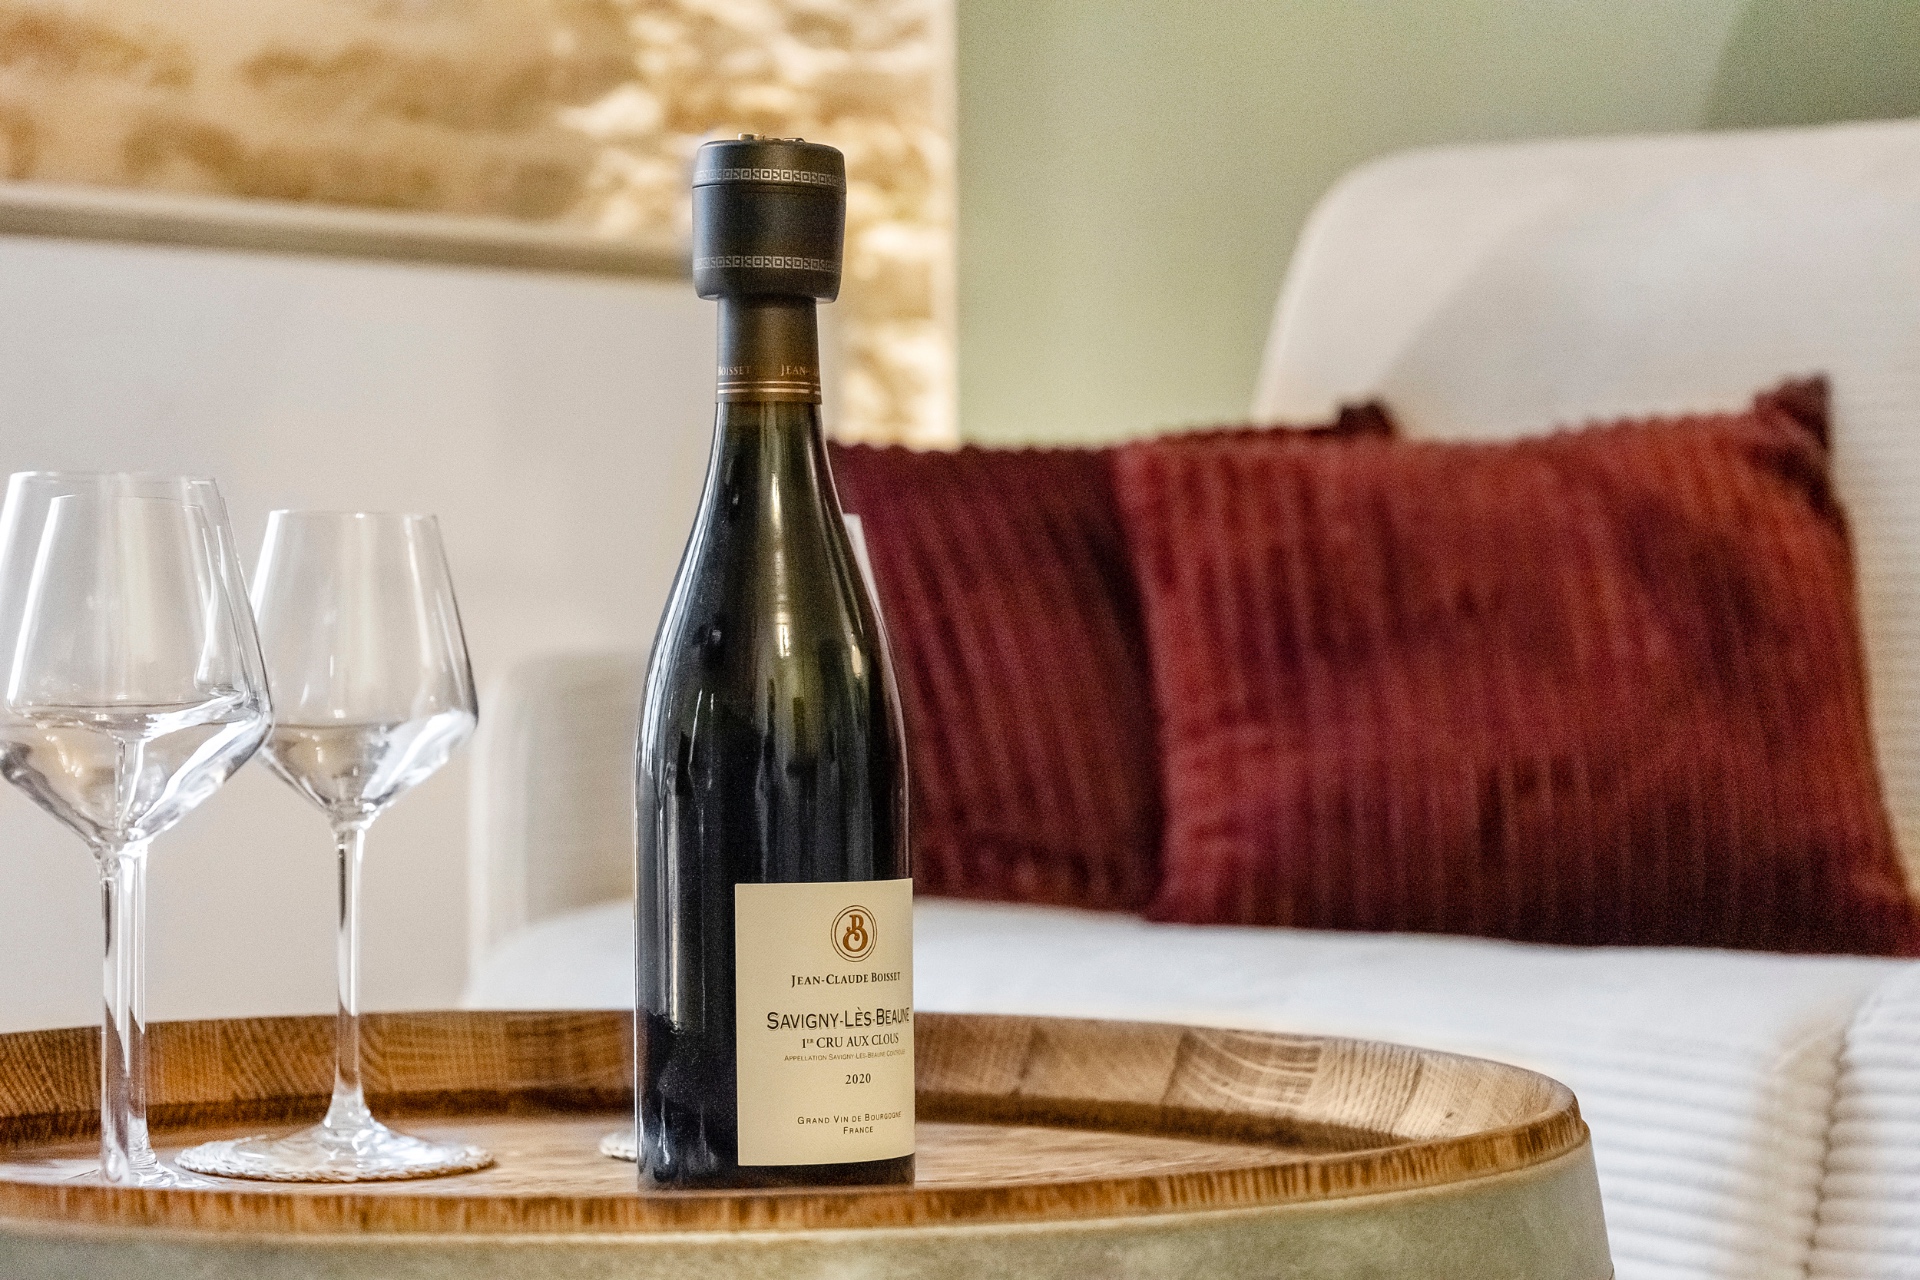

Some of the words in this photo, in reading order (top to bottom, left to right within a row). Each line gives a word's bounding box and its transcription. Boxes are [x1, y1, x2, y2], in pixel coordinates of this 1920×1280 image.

[791, 974, 869, 988] JEAN-CLAUDE
[871, 972, 900, 983] BOISSET
[766, 1007, 910, 1030] SAVIGNY-LÈS-BEAUNE
[816, 1037, 843, 1048] CRU
[846, 1035, 869, 1048] AUX
[871, 1033, 899, 1046] CLOUS
[845, 1073, 871, 1084] 2020
[797, 1116, 830, 1125] GRAND
[833, 1115, 849, 1123] VIN
[864, 1111, 901, 1121] BOURGOGNE
[843, 1126, 874, 1134] FRANCE
